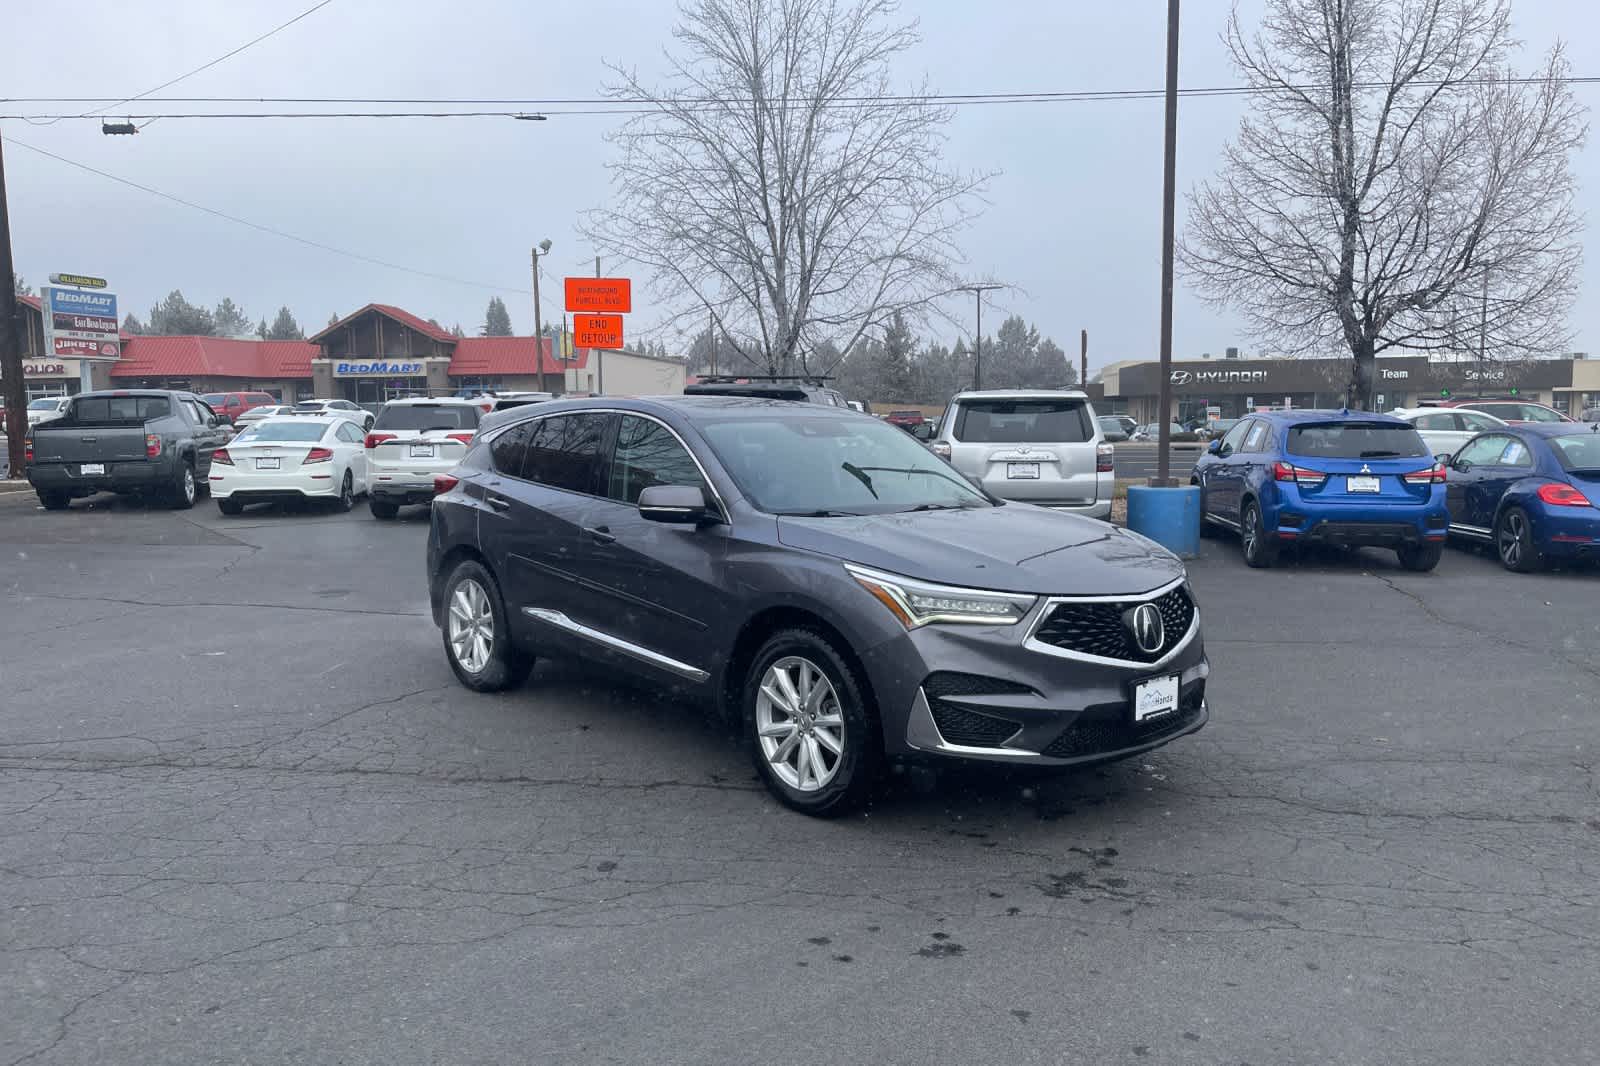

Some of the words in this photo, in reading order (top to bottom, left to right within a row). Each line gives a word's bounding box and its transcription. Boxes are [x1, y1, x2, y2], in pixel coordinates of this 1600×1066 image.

[589, 319, 607, 329] END
[581, 333, 616, 344] DETOUR
[23, 364, 65, 376] QUOR
[1380, 369, 1409, 379] Team
[1464, 370, 1505, 380] Sevice
[1196, 371, 1268, 384] HYUNDAI
